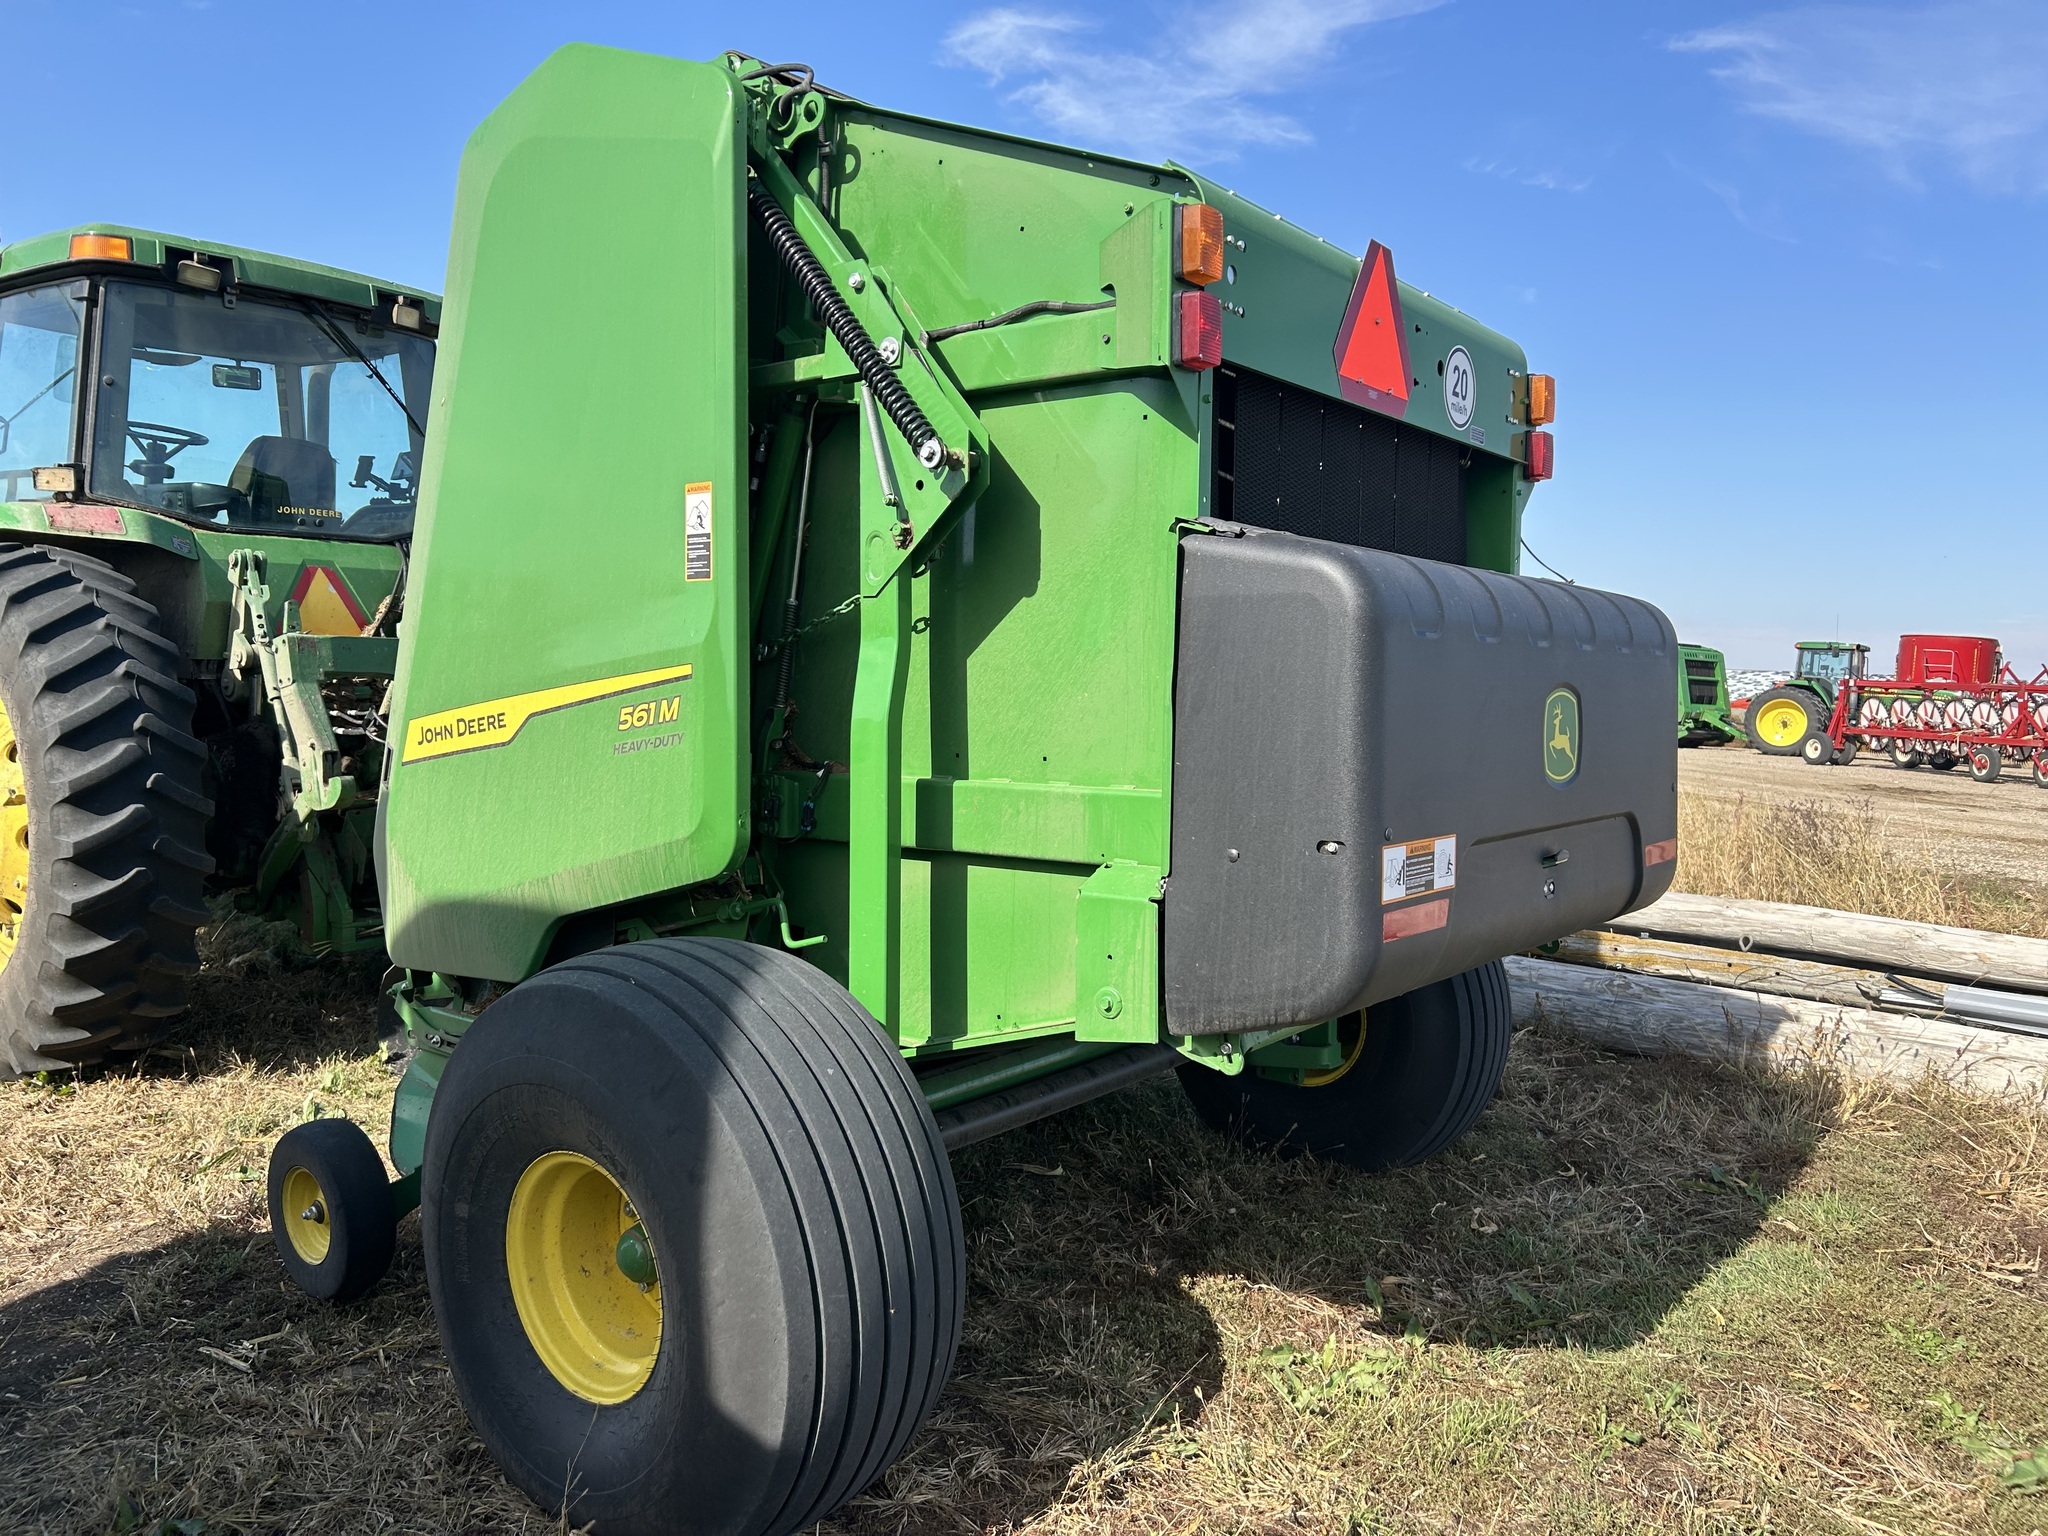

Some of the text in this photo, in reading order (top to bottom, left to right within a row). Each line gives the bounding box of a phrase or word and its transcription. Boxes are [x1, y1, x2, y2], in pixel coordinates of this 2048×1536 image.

[1451, 364, 1468, 401] 20
[277, 505, 341, 518] JOHN DEERE
[417, 712, 507, 746] JOHN DEERE
[613, 732, 685, 755] HEAVY-DUTY
